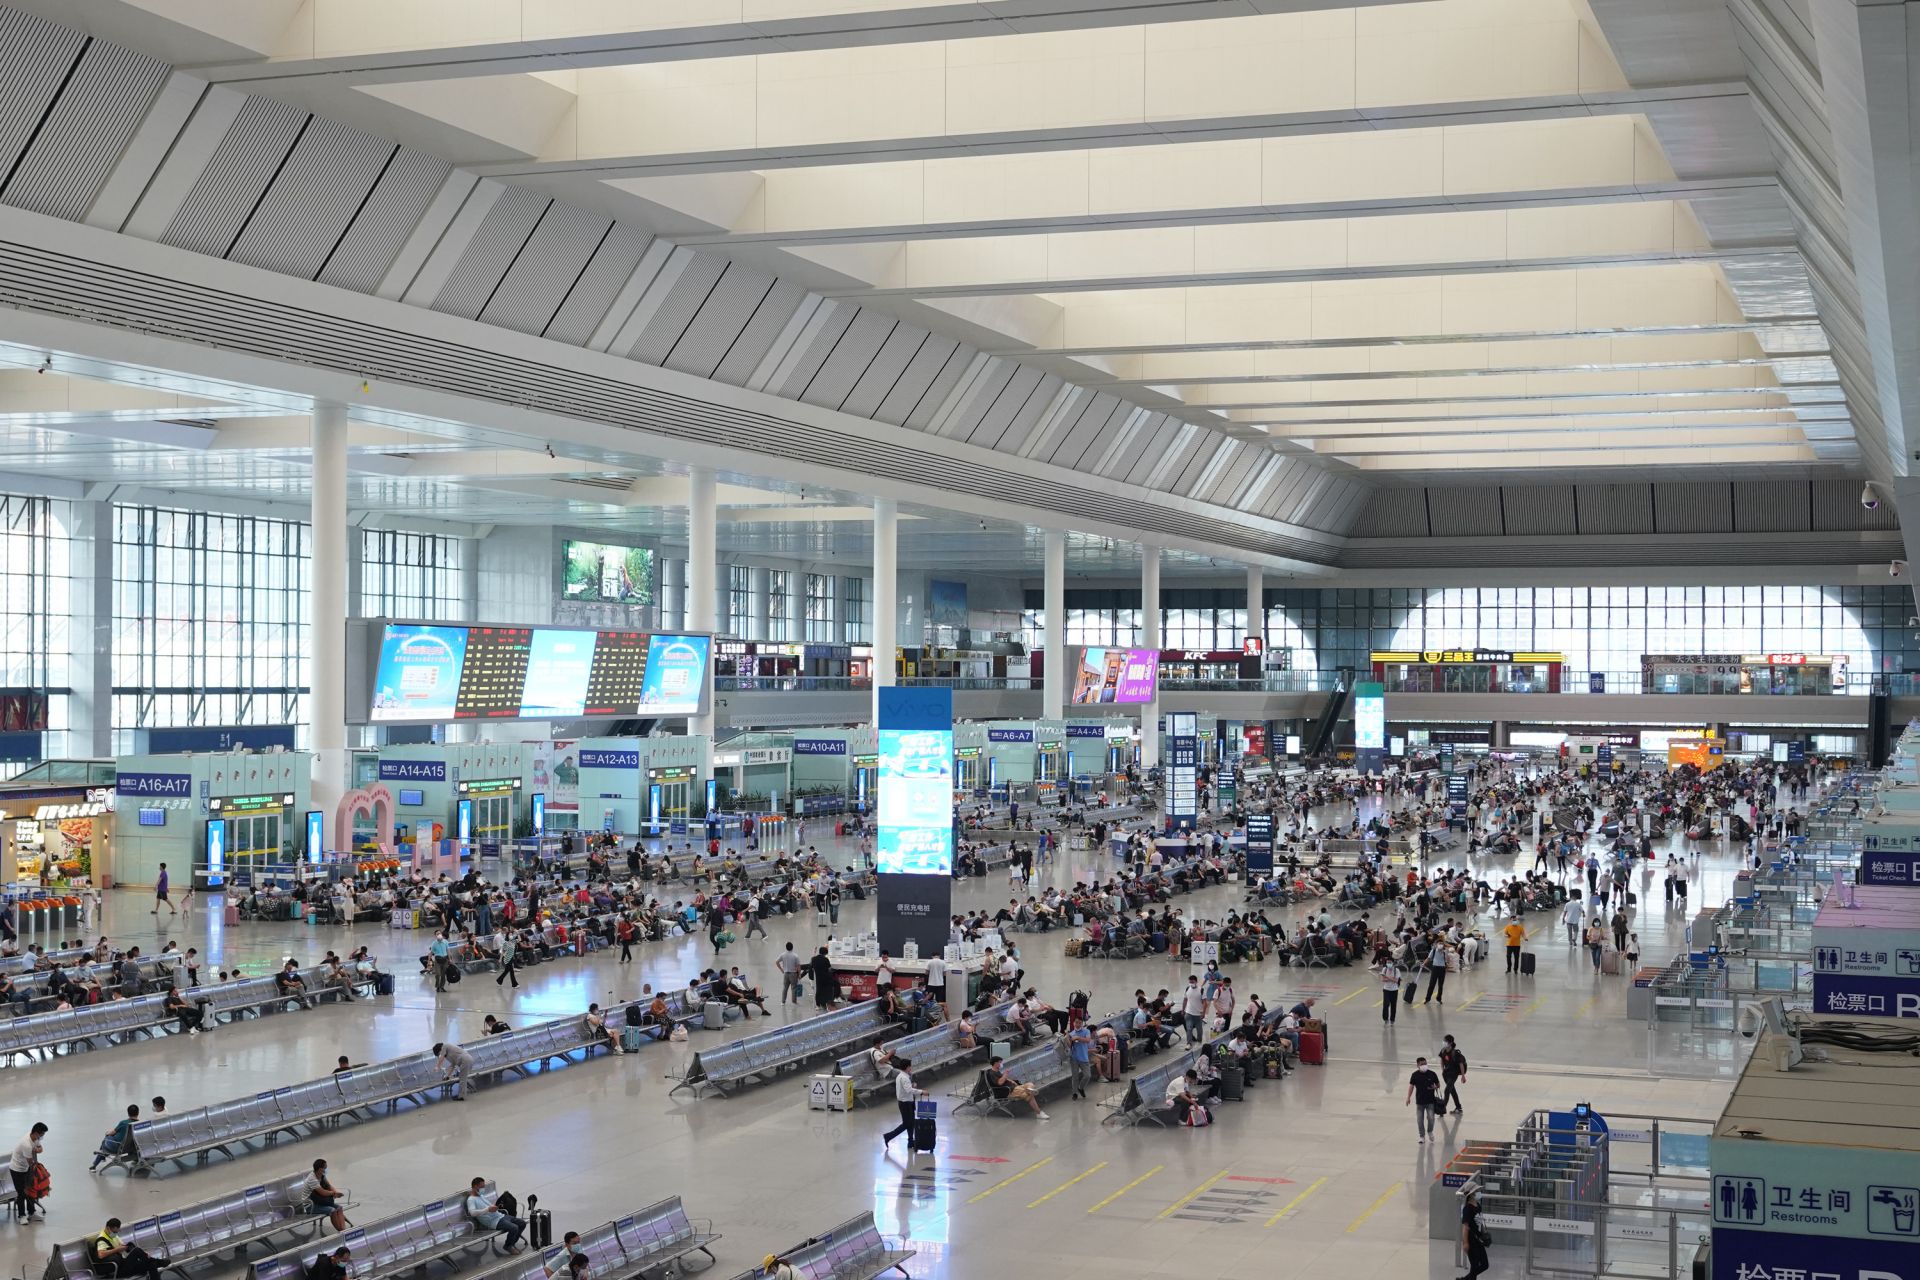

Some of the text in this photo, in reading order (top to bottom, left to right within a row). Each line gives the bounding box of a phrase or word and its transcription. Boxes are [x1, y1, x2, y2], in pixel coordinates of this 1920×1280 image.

[1184, 652, 1208, 660] KFC
[1002, 732, 1031, 740] A6-A7
[1076, 728, 1103, 736] A4-A5
[810, 743, 845, 752] A10-A11
[596, 753, 637, 765] A12-A13
[398, 765, 444, 777] A14-A15
[138, 778, 189, 792] A16-A17
[1872, 861, 1906, 873] 检票口
[1844, 952, 1887, 965] 卫生间
[1828, 992, 1885, 1012] 检票口
[1770, 1186, 1850, 1213] 卫生间
[1771, 1210, 1838, 1225] Restrooms
